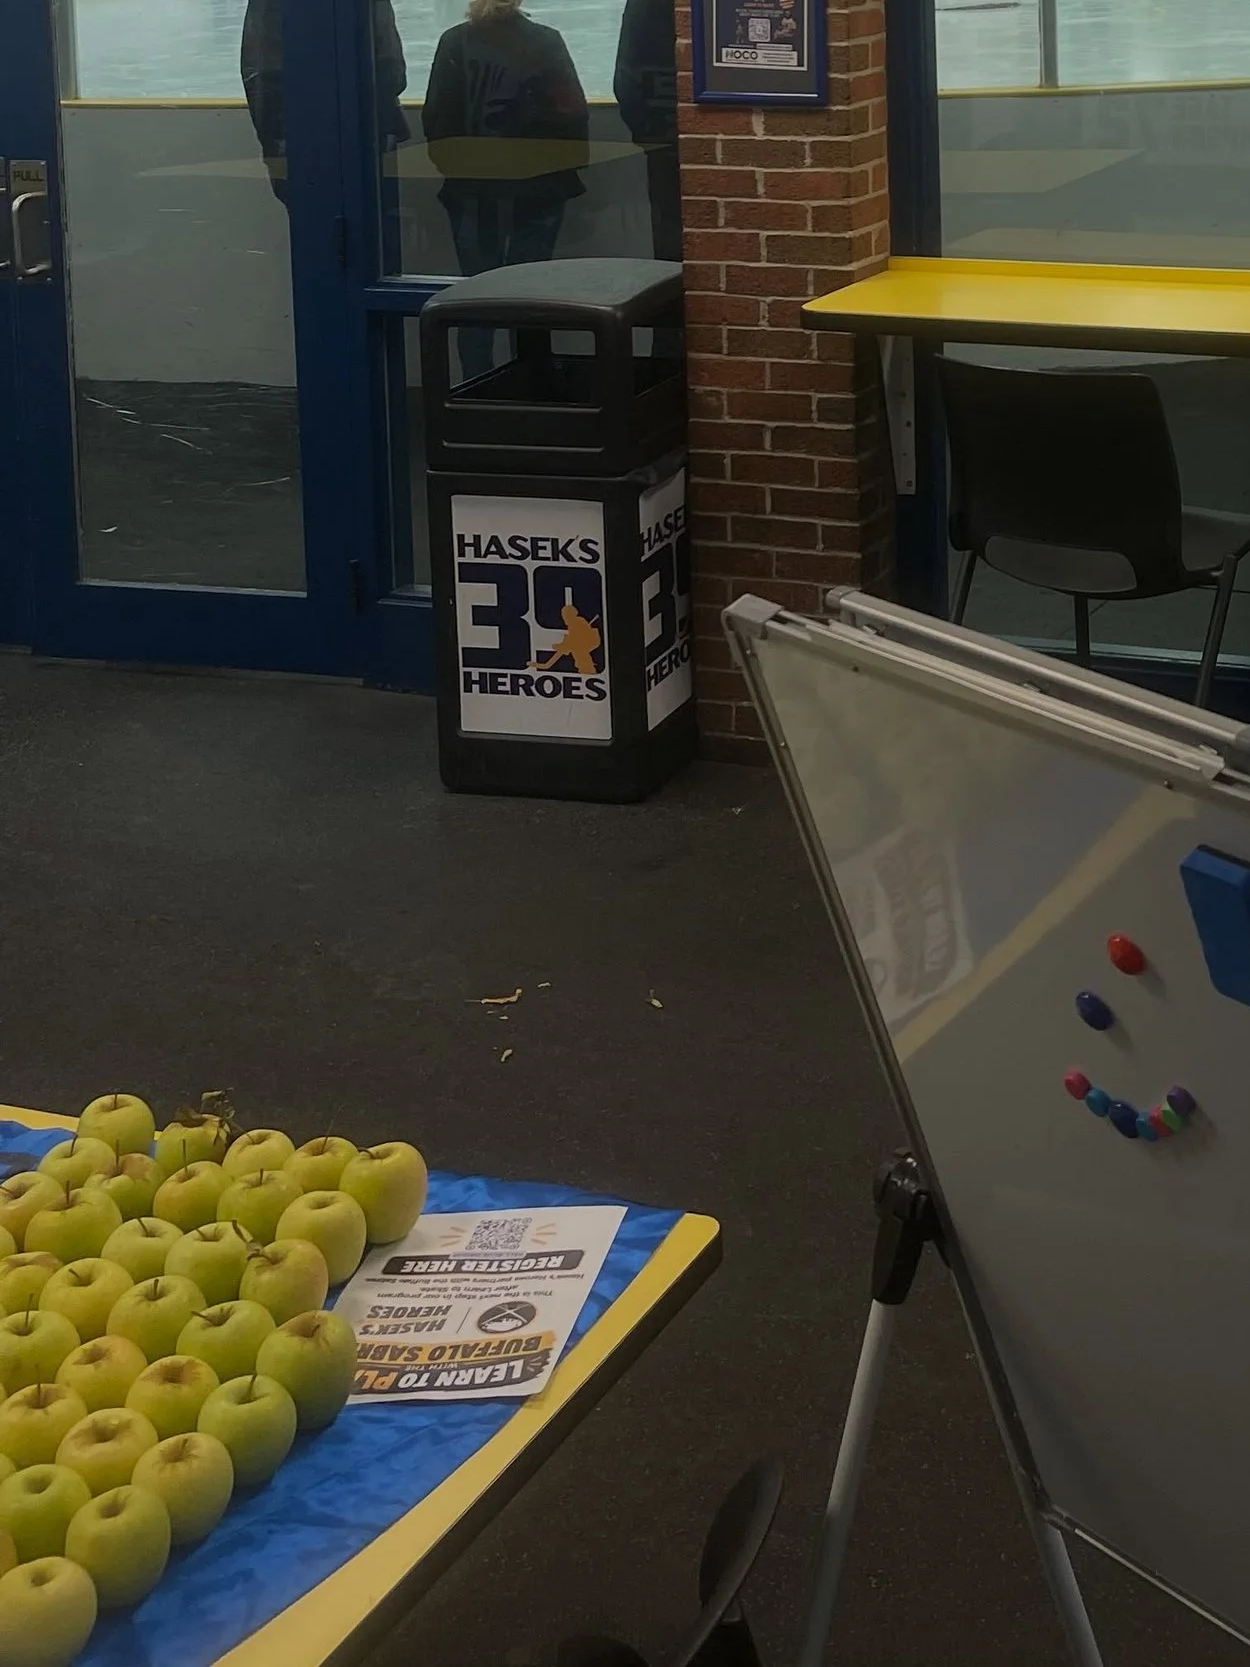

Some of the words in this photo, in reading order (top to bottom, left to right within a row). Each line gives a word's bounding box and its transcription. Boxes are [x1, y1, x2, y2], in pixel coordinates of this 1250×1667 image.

[13, 170, 45, 183] PULL
[456, 533, 601, 565] HASEK'S
[462, 670, 608, 702] HEROES
[399, 1260, 457, 1273] HERE
[464, 1255, 565, 1272] REGISTER
[377, 1292, 422, 1300] program
[366, 1304, 453, 1320] HEROES
[358, 1318, 448, 1336] HASEK'S
[356, 1341, 424, 1364] SABR
[428, 1335, 543, 1363] BUFFALO
[404, 1363, 426, 1372] THE
[428, 1362, 459, 1372] WITH
[433, 1358, 526, 1388] LEARN
[354, 1368, 399, 1391] PL
[397, 1371, 432, 1389] TO
